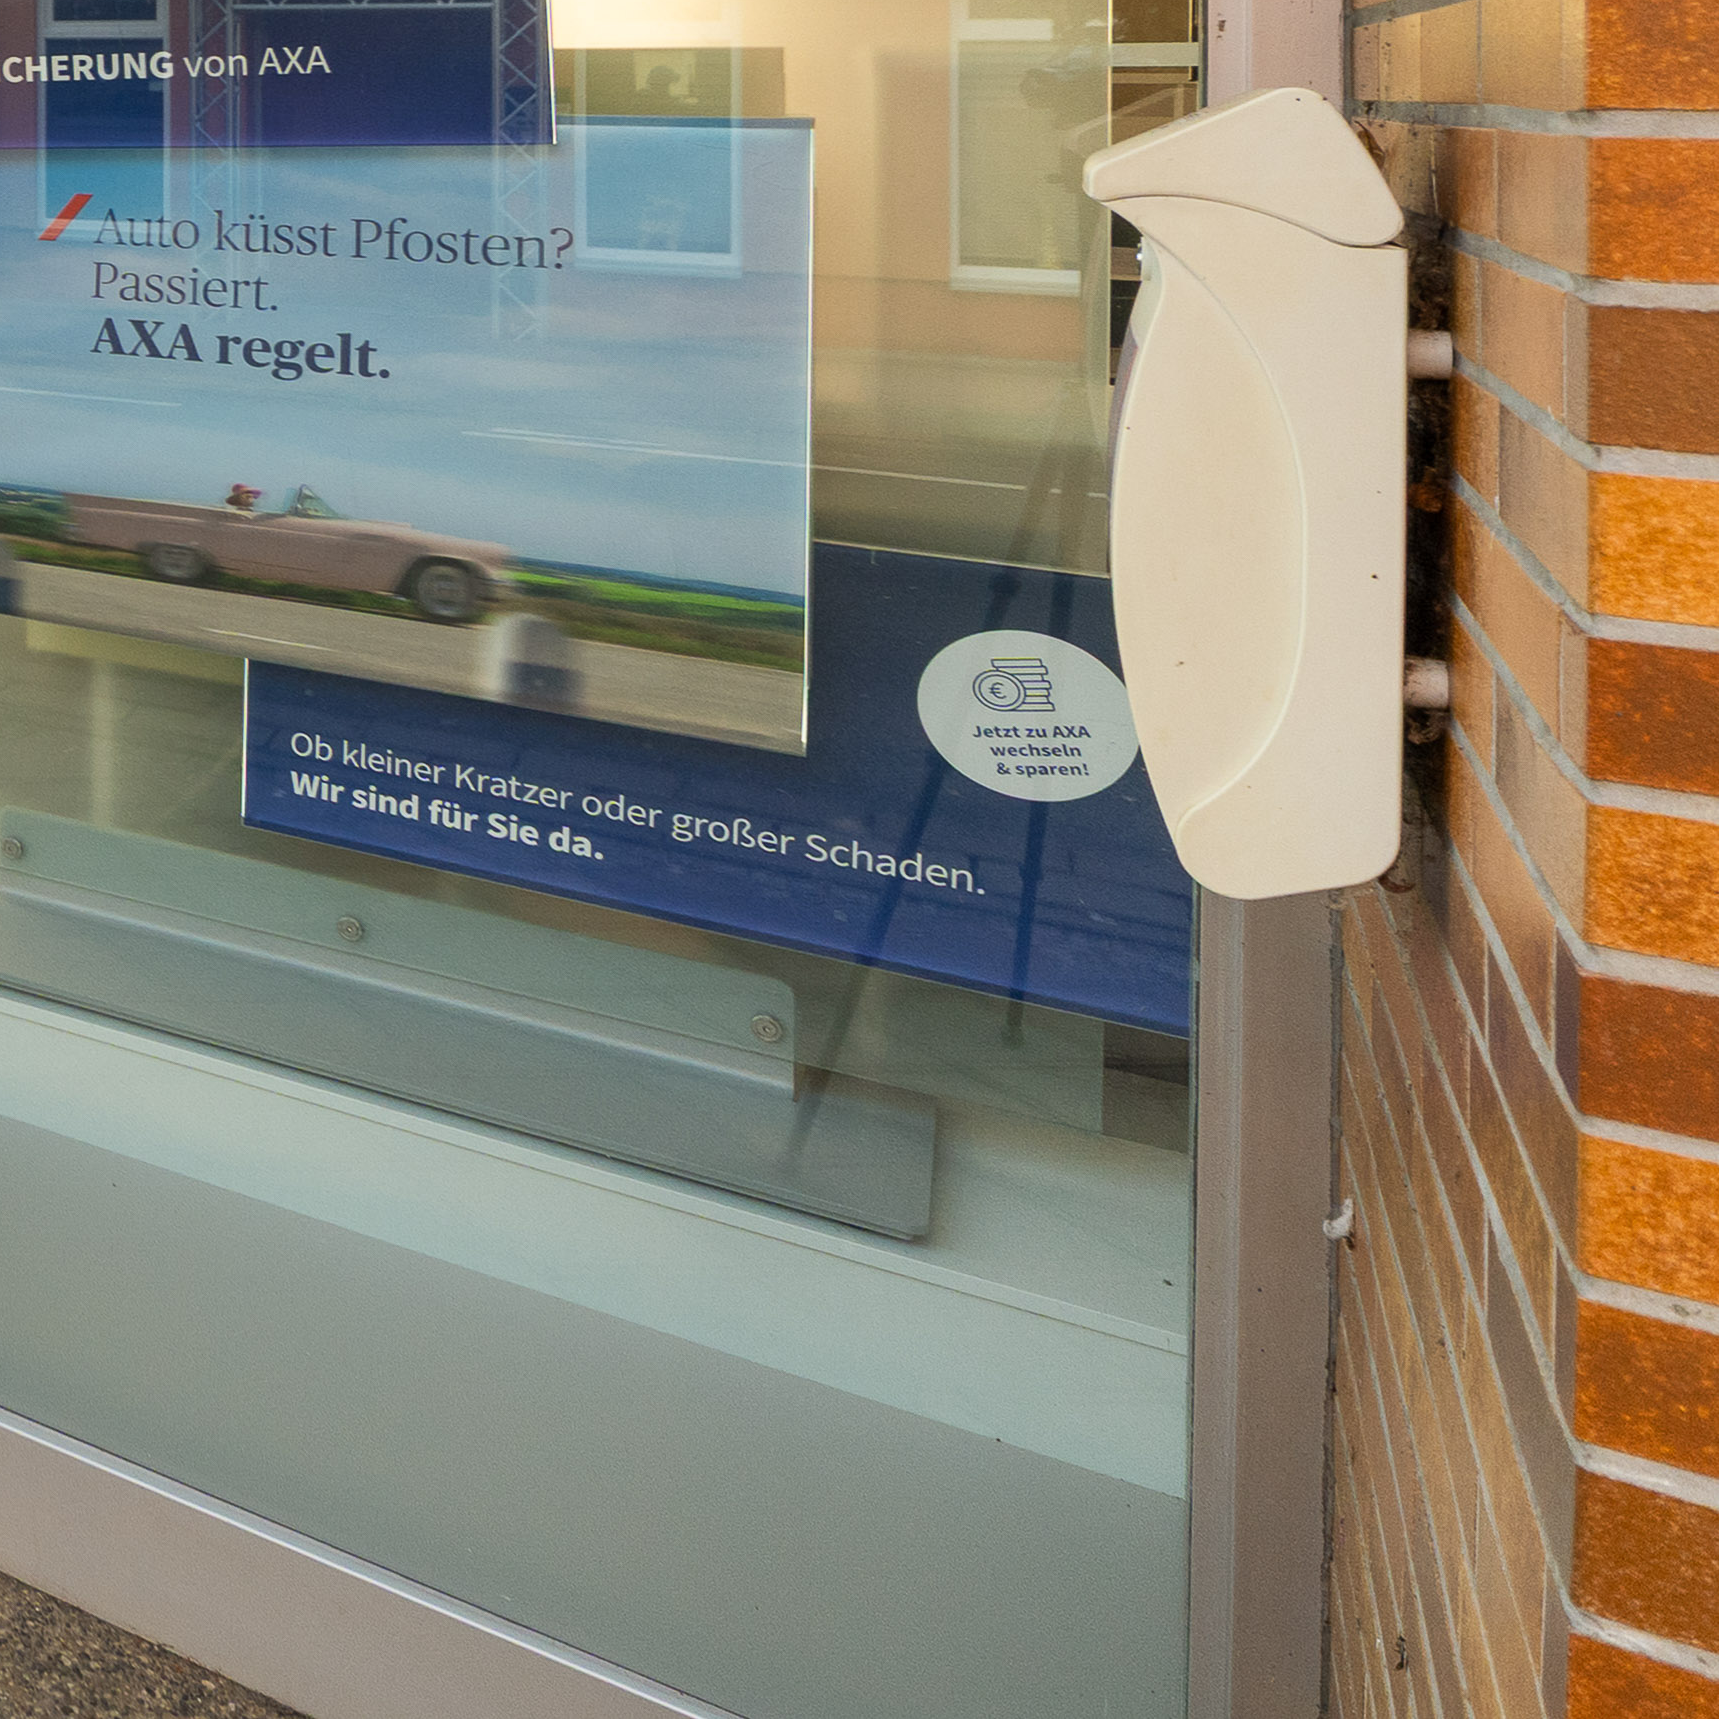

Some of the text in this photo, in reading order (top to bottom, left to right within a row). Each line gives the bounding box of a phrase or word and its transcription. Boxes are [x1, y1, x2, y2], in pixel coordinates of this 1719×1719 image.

[182, 53, 249, 79] von
[258, 46, 332, 77] AXA
[93, 208, 574, 270] Auto küsst Pfosten?
[91, 261, 279, 312] Passiert.
[90, 317, 391, 381] AXA regelt.
[973, 725, 1092, 739] Jetzt zu AXA
[990, 743, 1082, 758] wechseln
[996, 761, 1090, 779] & sparen!
[290, 731, 986, 896] Ob kleiner Kratzer oder großer Schaden.
[290, 771, 605, 861] Wir sind für Sie da.
